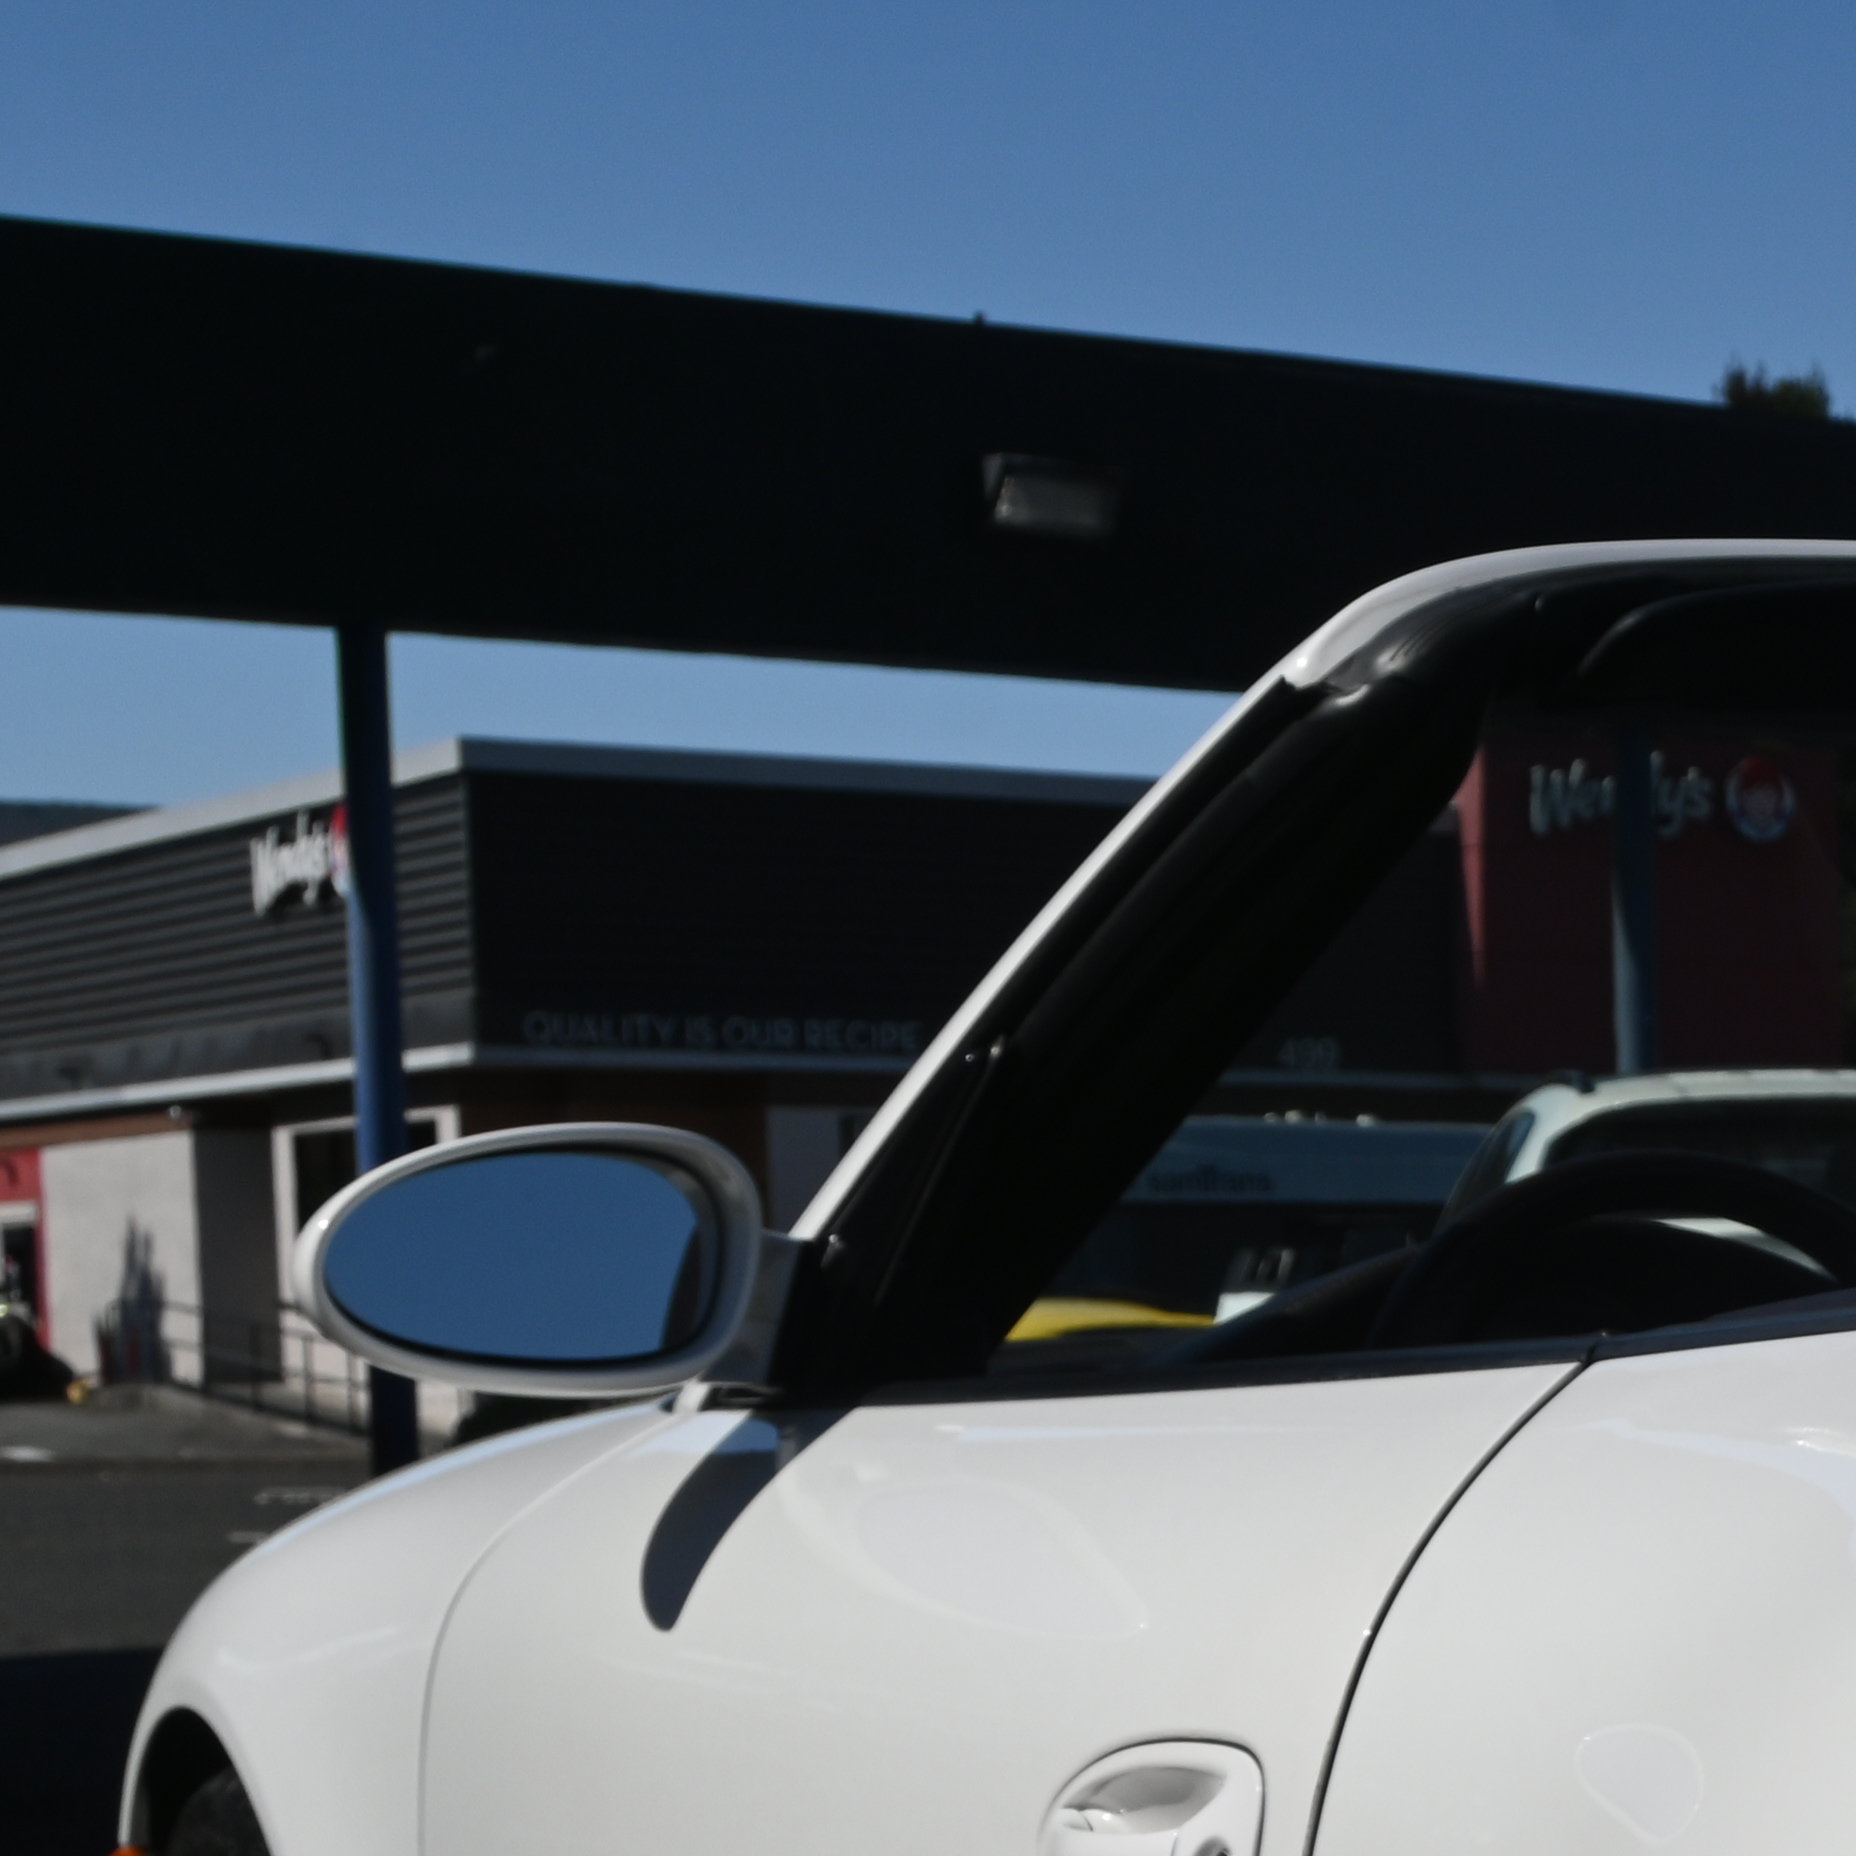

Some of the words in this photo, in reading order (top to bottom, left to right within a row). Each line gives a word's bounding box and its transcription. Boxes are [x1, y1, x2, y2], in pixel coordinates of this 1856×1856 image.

[1529, 748, 1716, 838] Weny's
[522, 1009, 677, 1045] QUALITY
[684, 1014, 718, 1048] IS
[721, 1014, 798, 1050] OUR
[805, 1017, 923, 1053] RECIPE
